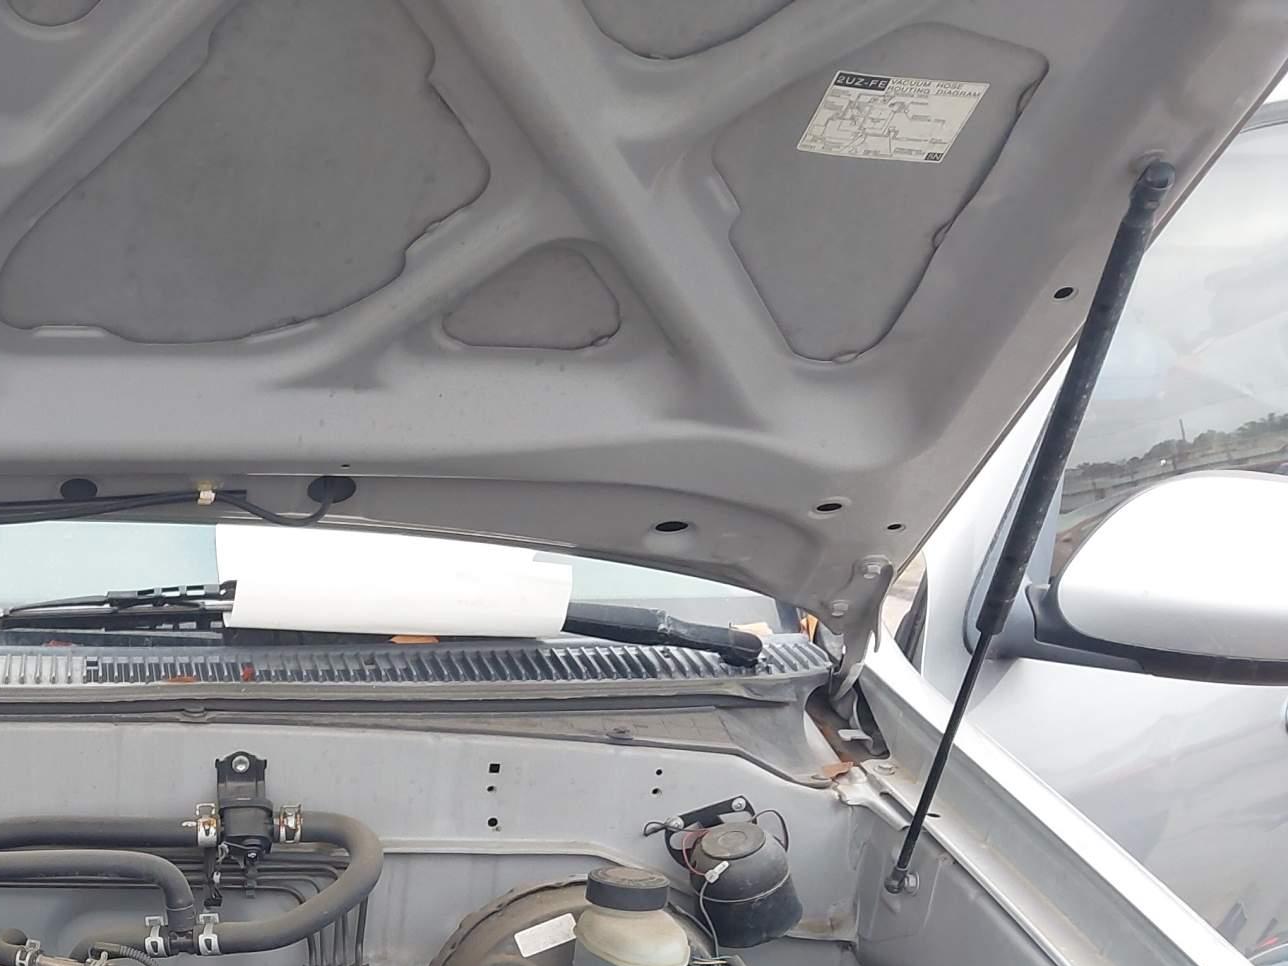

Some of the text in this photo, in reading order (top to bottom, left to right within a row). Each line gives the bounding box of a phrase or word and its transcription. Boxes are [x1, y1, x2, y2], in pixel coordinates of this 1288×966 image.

[836, 74, 887, 89] 2UZ-FE
[890, 79, 932, 88] VACUUM
[888, 85, 931, 95] ROUTING
[935, 89, 982, 97] DIAGRAM
